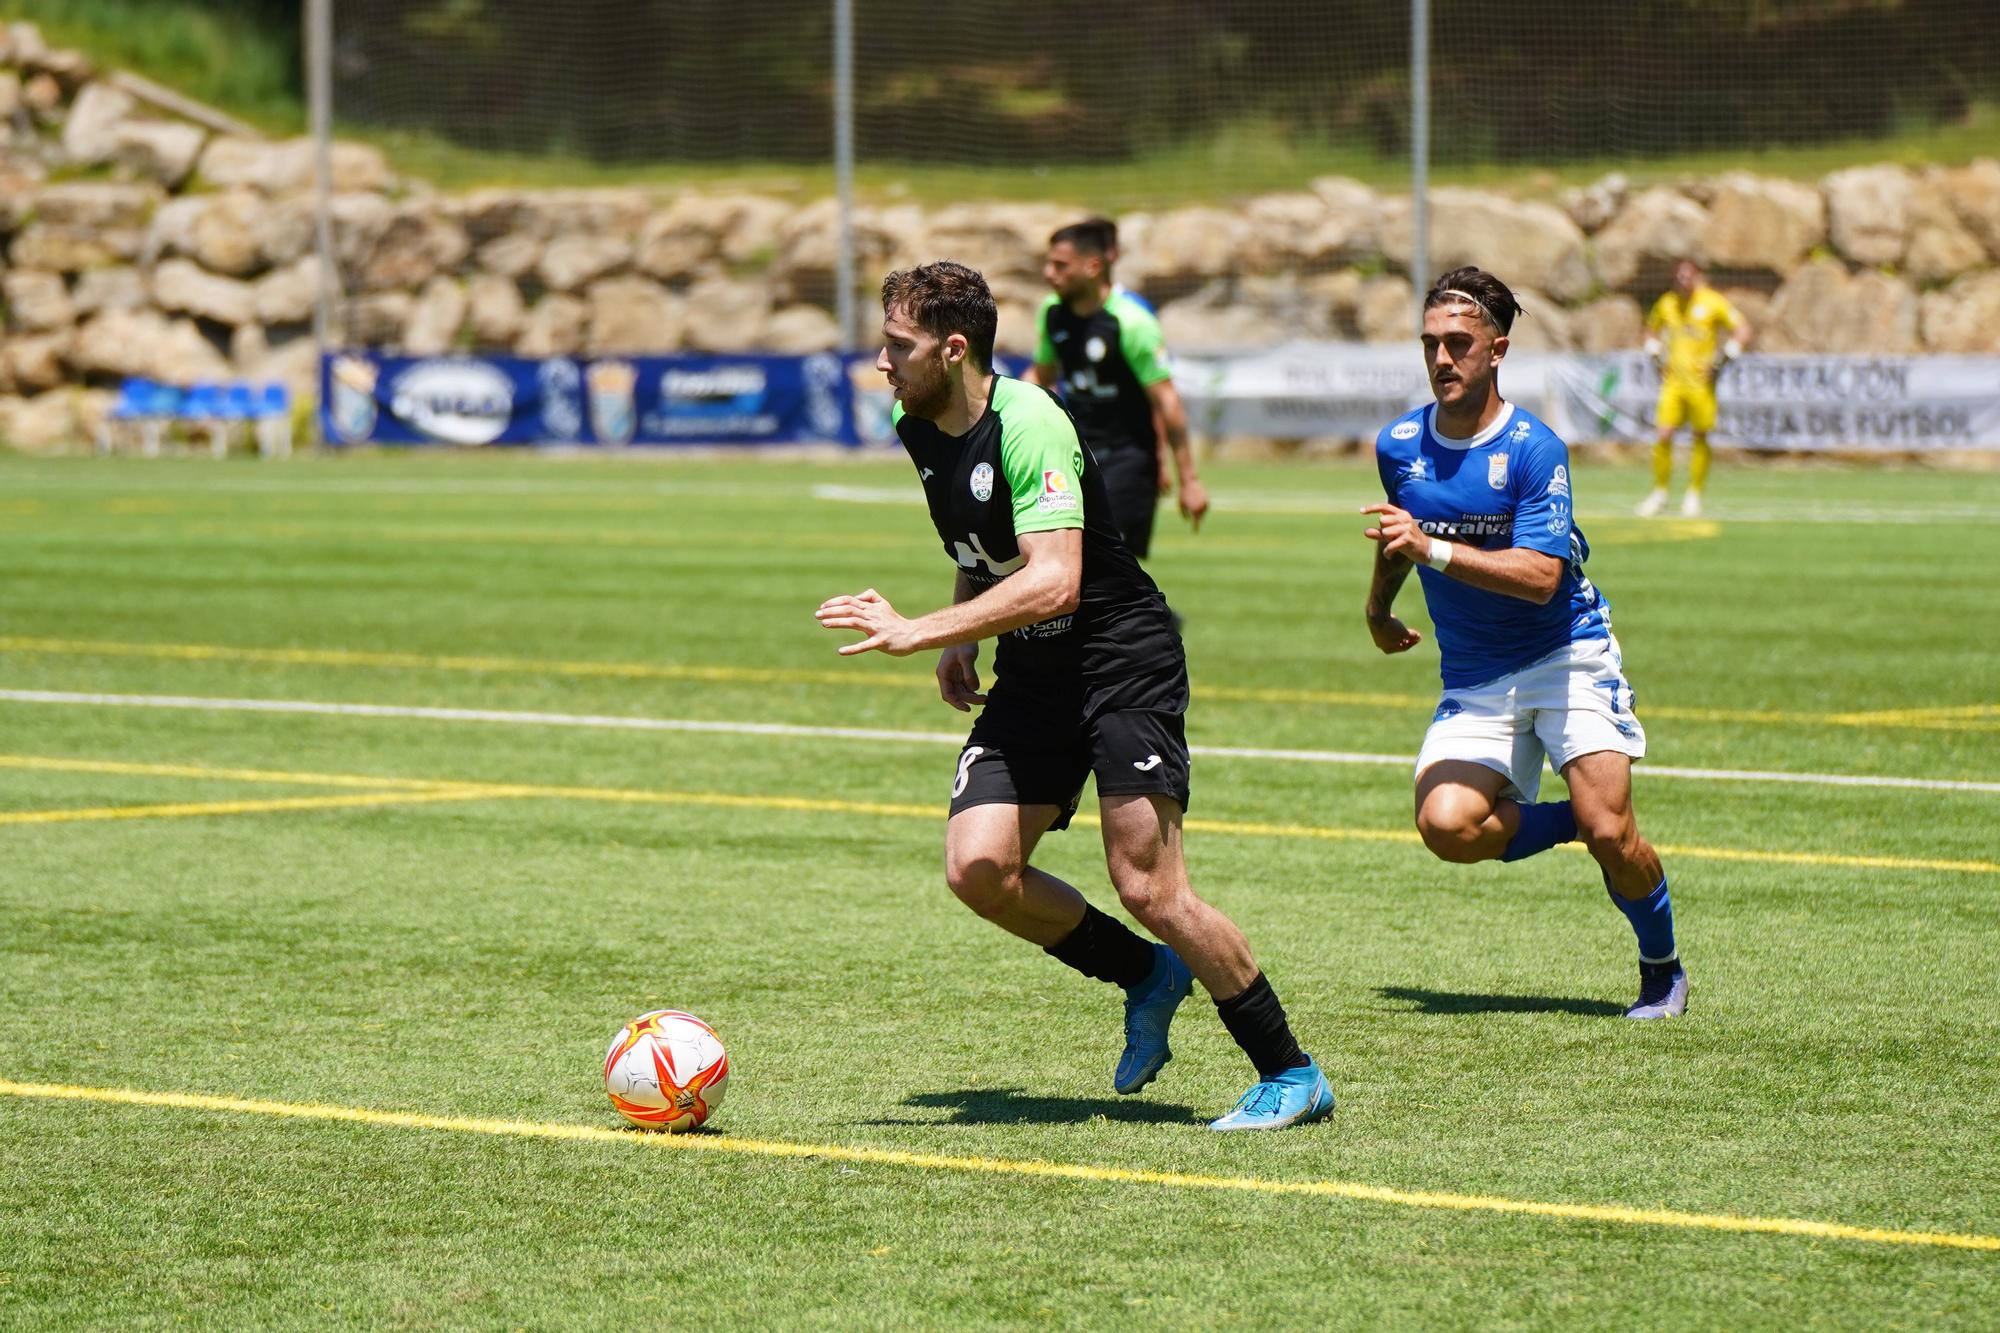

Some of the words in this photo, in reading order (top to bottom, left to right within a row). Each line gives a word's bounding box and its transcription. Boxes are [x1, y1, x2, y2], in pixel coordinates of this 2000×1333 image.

[1392, 426, 1418, 436] LUGO
[1592, 679, 1620, 714] 7
[951, 746, 984, 799] 8
